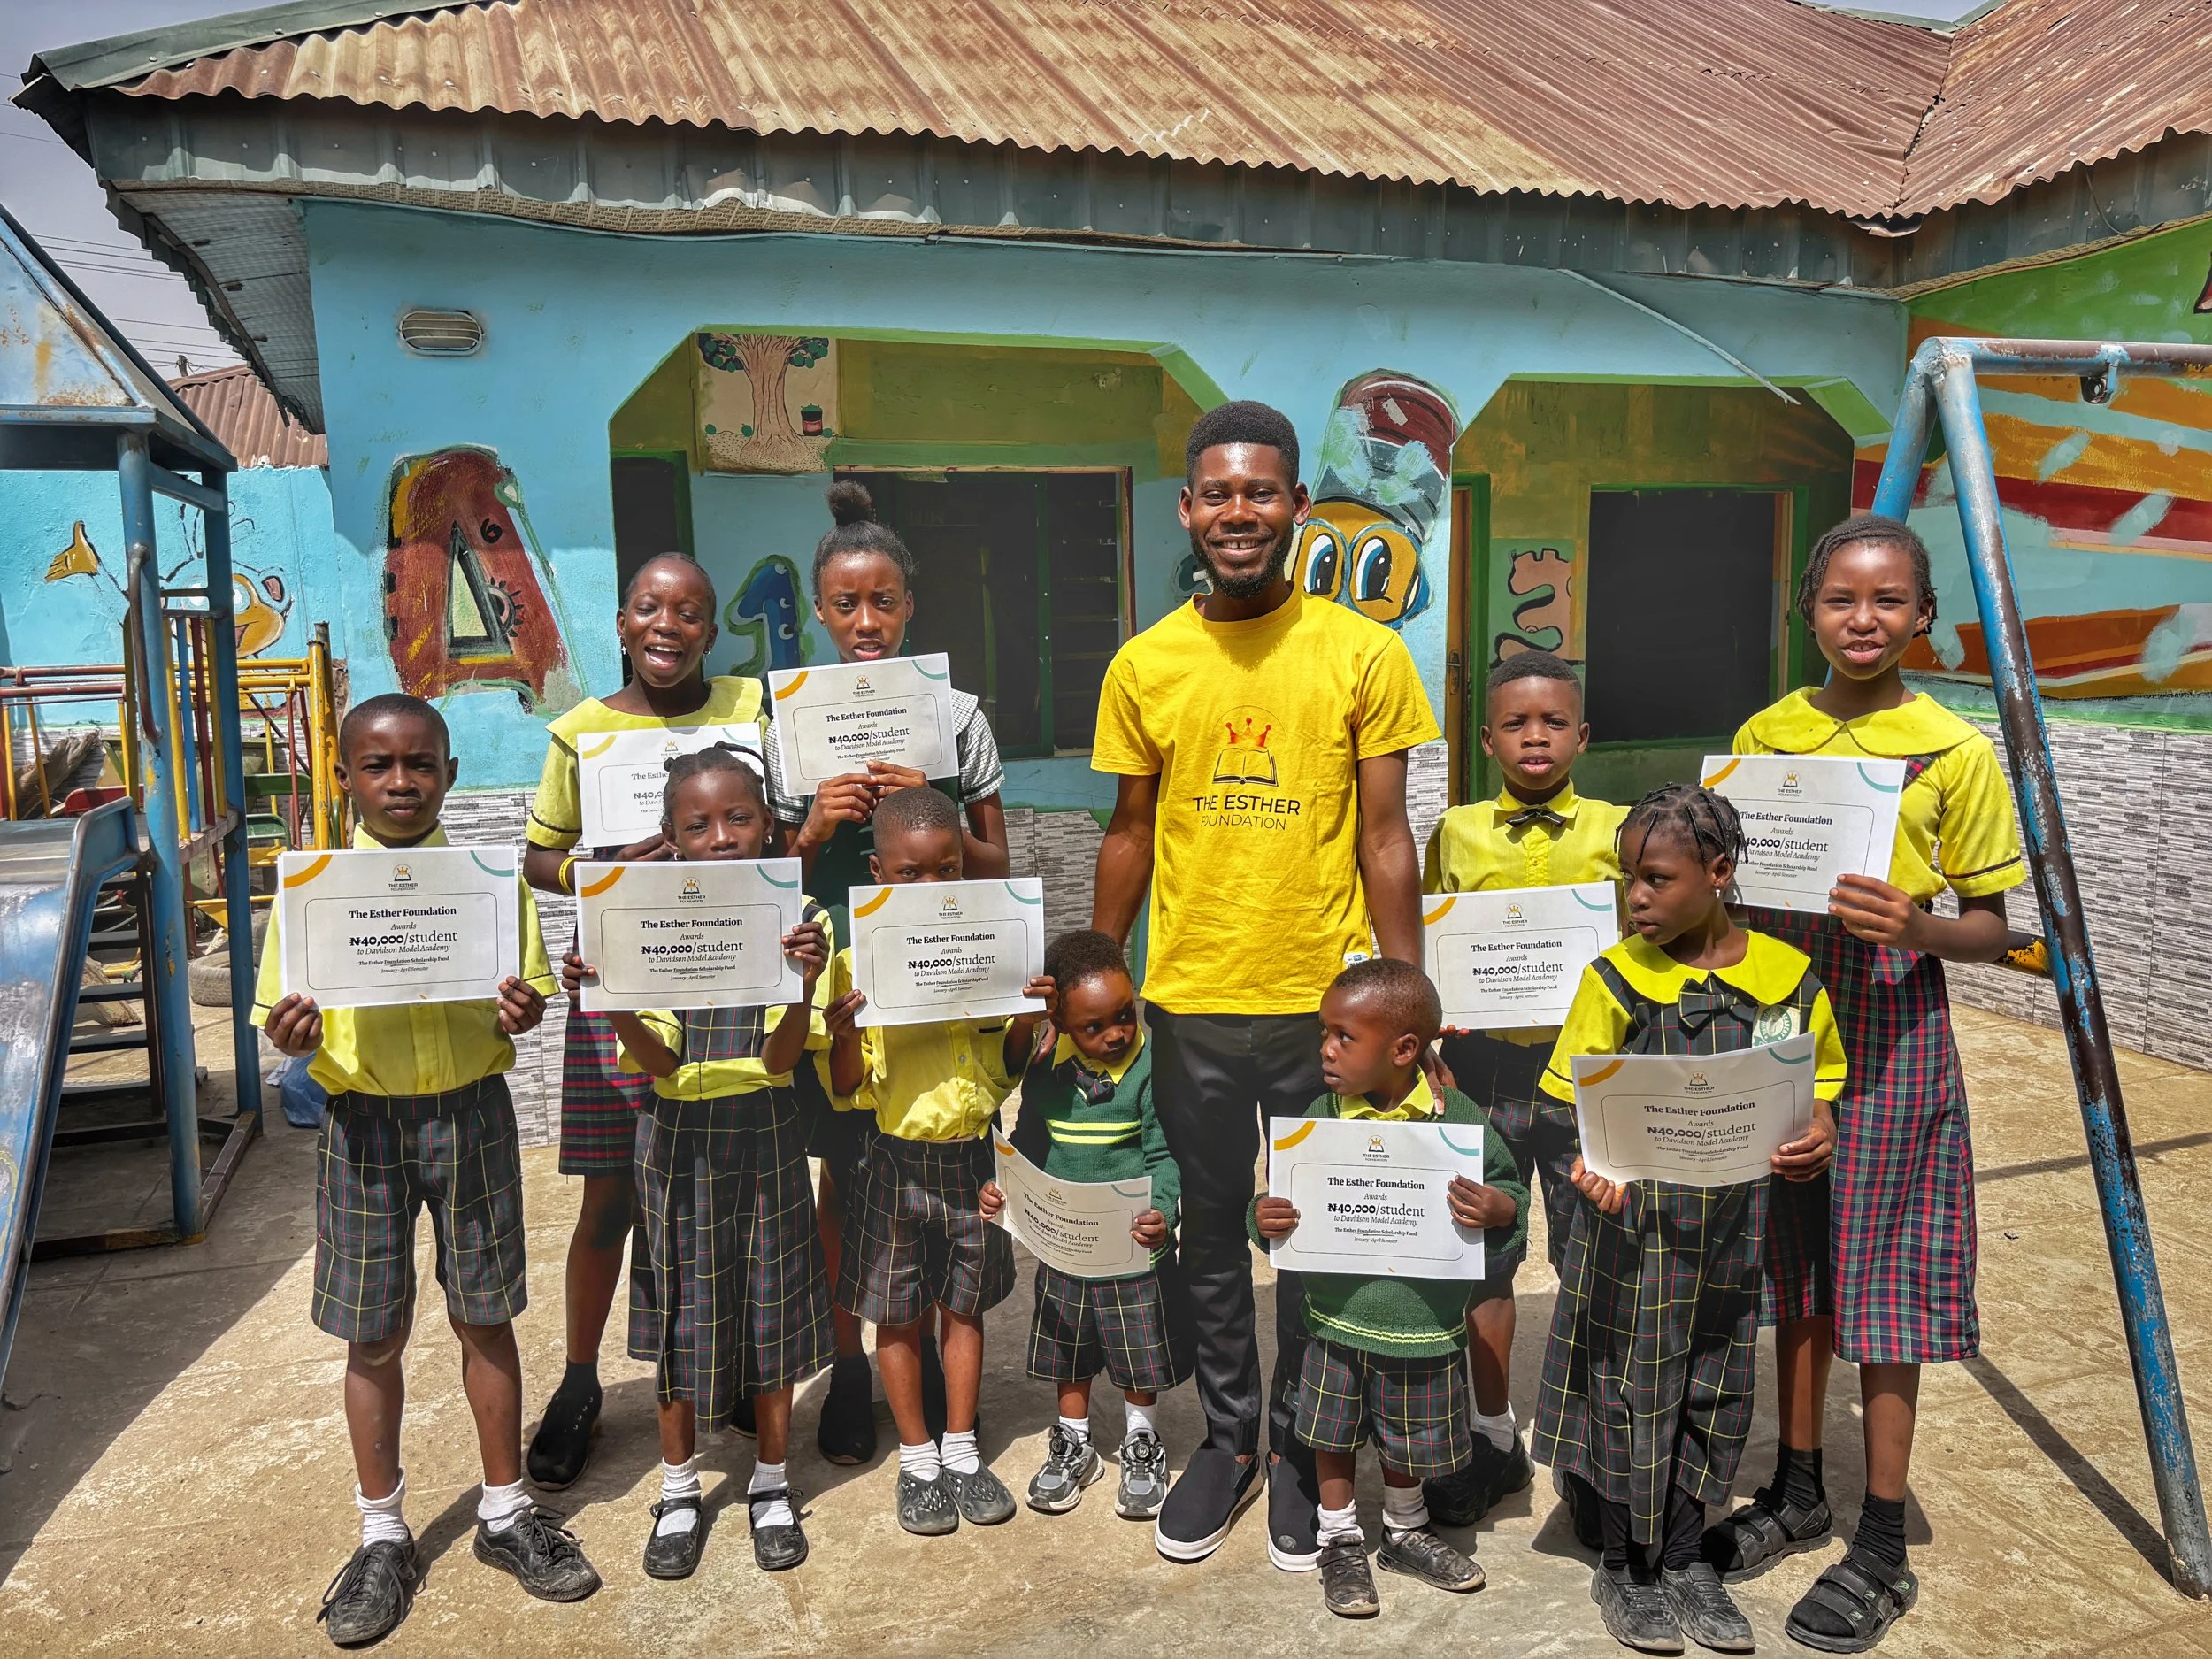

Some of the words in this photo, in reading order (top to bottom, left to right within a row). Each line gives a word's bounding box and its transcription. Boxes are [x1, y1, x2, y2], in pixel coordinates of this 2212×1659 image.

[1192, 795, 1218, 811] THE
[1224, 795, 1300, 815] ESTHER
[1201, 815, 1286, 830] FOUNDATION
[1740, 811, 1755, 820] The
[1756, 812, 1784, 822] Esther
[1784, 815, 1833, 825] Foundation
[1792, 853, 1820, 862] Academy
[349, 910, 368, 919] The
[370, 909, 402, 918] Esther
[403, 906, 457, 917] Foundation
[391, 922, 417, 930] Awards
[640, 920, 659, 929] The
[660, 920, 691, 928] Esther
[692, 918, 743, 928] Foundation
[907, 936, 923, 945] The
[924, 935, 951, 944] Esther
[951, 932, 995, 943] Foundation
[366, 947, 398, 955] Davidson
[399, 945, 420, 953] Model
[1488, 943, 1515, 951] Esther
[1516, 940, 1562, 950] Foundation
[1666, 1106, 1698, 1116] Esther
[1700, 1102, 1755, 1116] Foundation
[1663, 1136, 1695, 1145] Davidson
[1718, 1134, 1749, 1144] Academy
[1328, 1177, 1345, 1186] The
[1346, 1178, 1375, 1187] Esther
[1376, 1180, 1425, 1189] Foundation
[1034, 1202, 1054, 1217] Esther
[1055, 1214, 1098, 1225] Foundation
[1390, 1218, 1418, 1227] Academy
